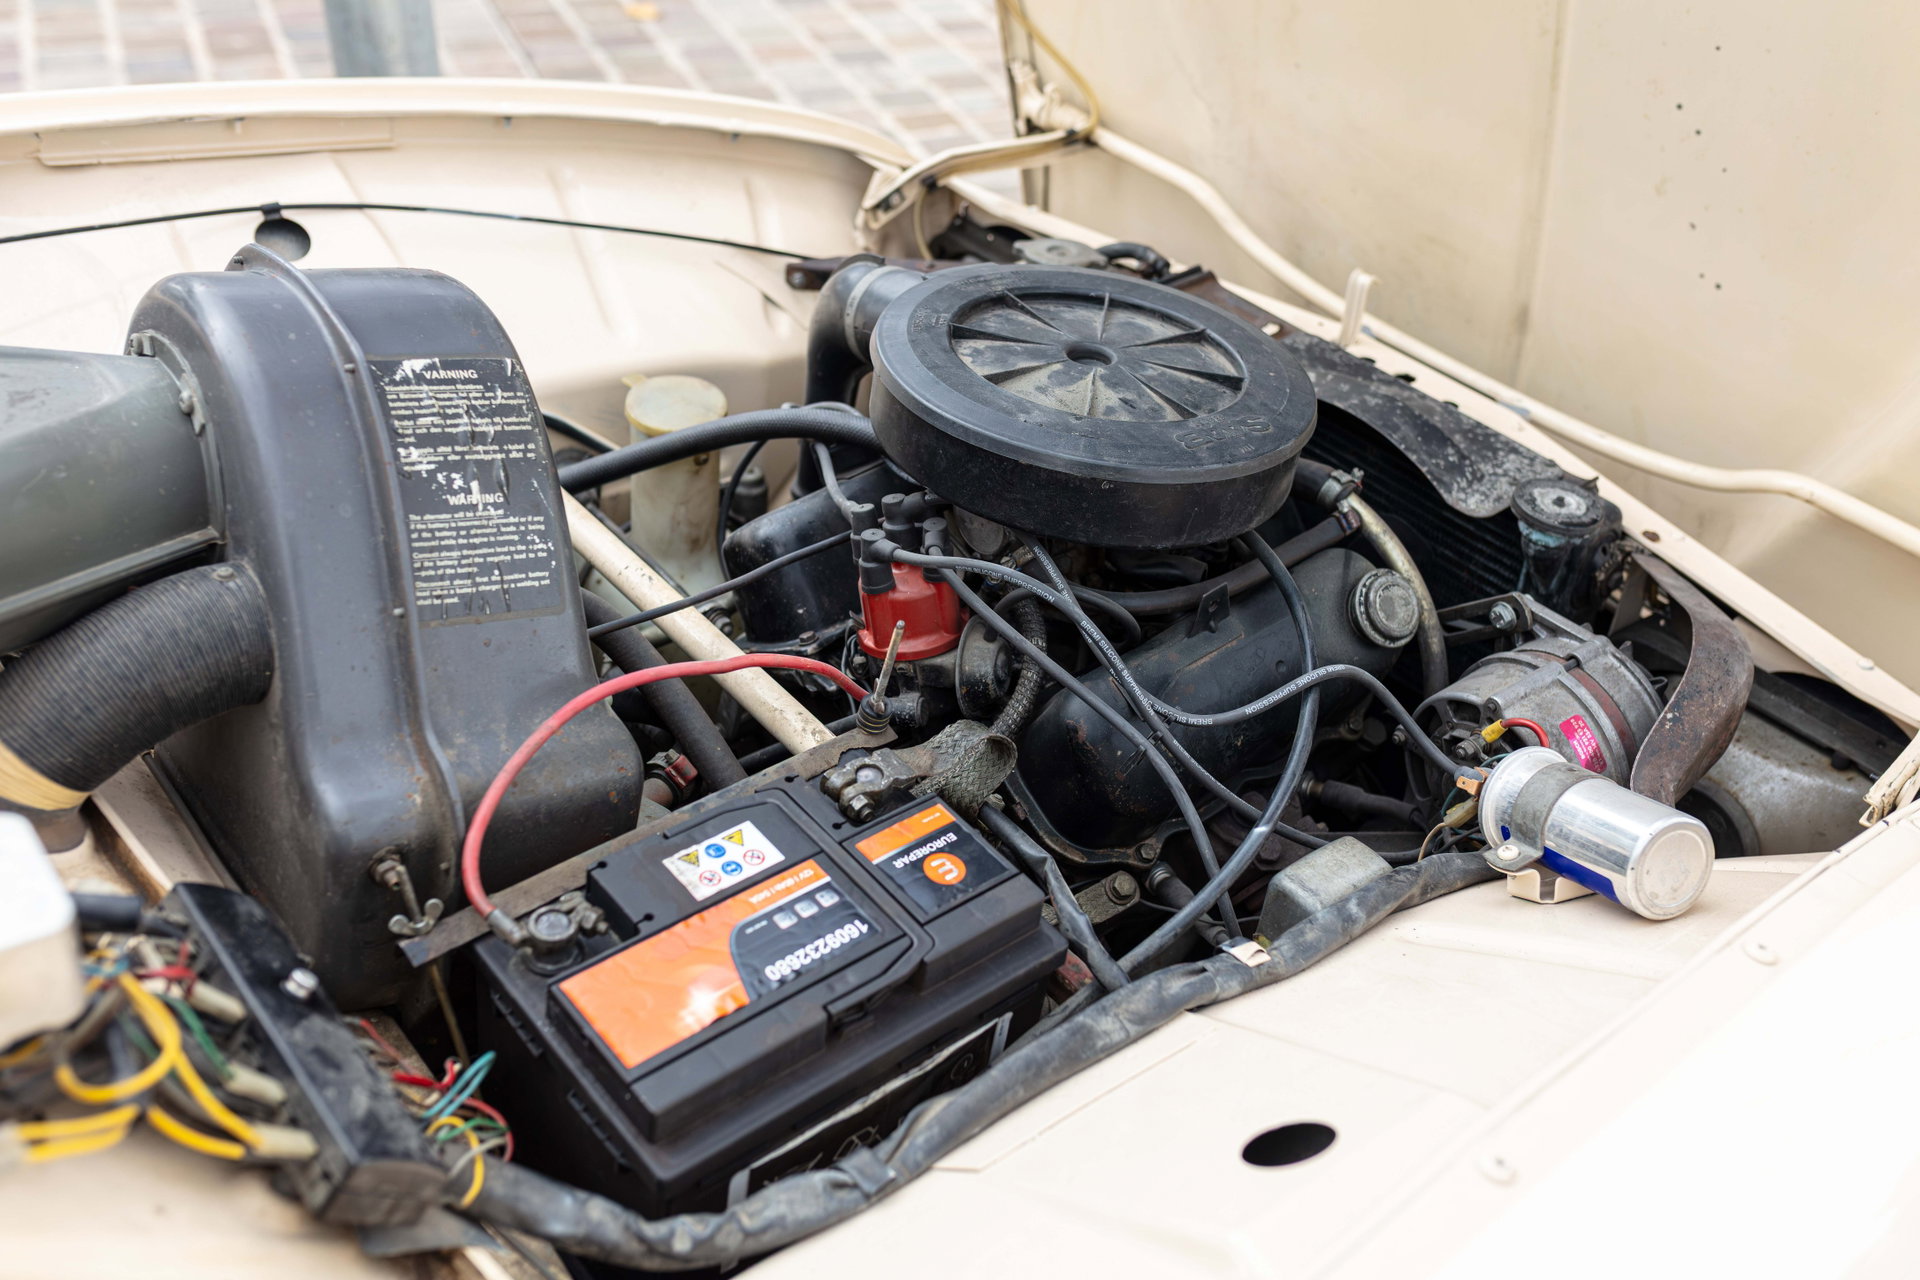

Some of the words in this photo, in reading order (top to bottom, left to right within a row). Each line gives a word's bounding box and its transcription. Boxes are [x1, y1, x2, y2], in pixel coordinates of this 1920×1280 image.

[422, 369, 478, 379] VARNING
[446, 493, 504, 505] WARING
[1002, 572, 1055, 604] SUPPRESSION
[1080, 619, 1101, 645] BREMI
[1099, 639, 1123, 672] SILICONE
[1301, 667, 1327, 684] SILICONE
[1245, 677, 1303, 716] SUPPRESSION
[1573, 740, 1585, 759] BOSCH
[893, 832, 958, 869] EUROREPAR
[764, 919, 869, 982] 1609232680
